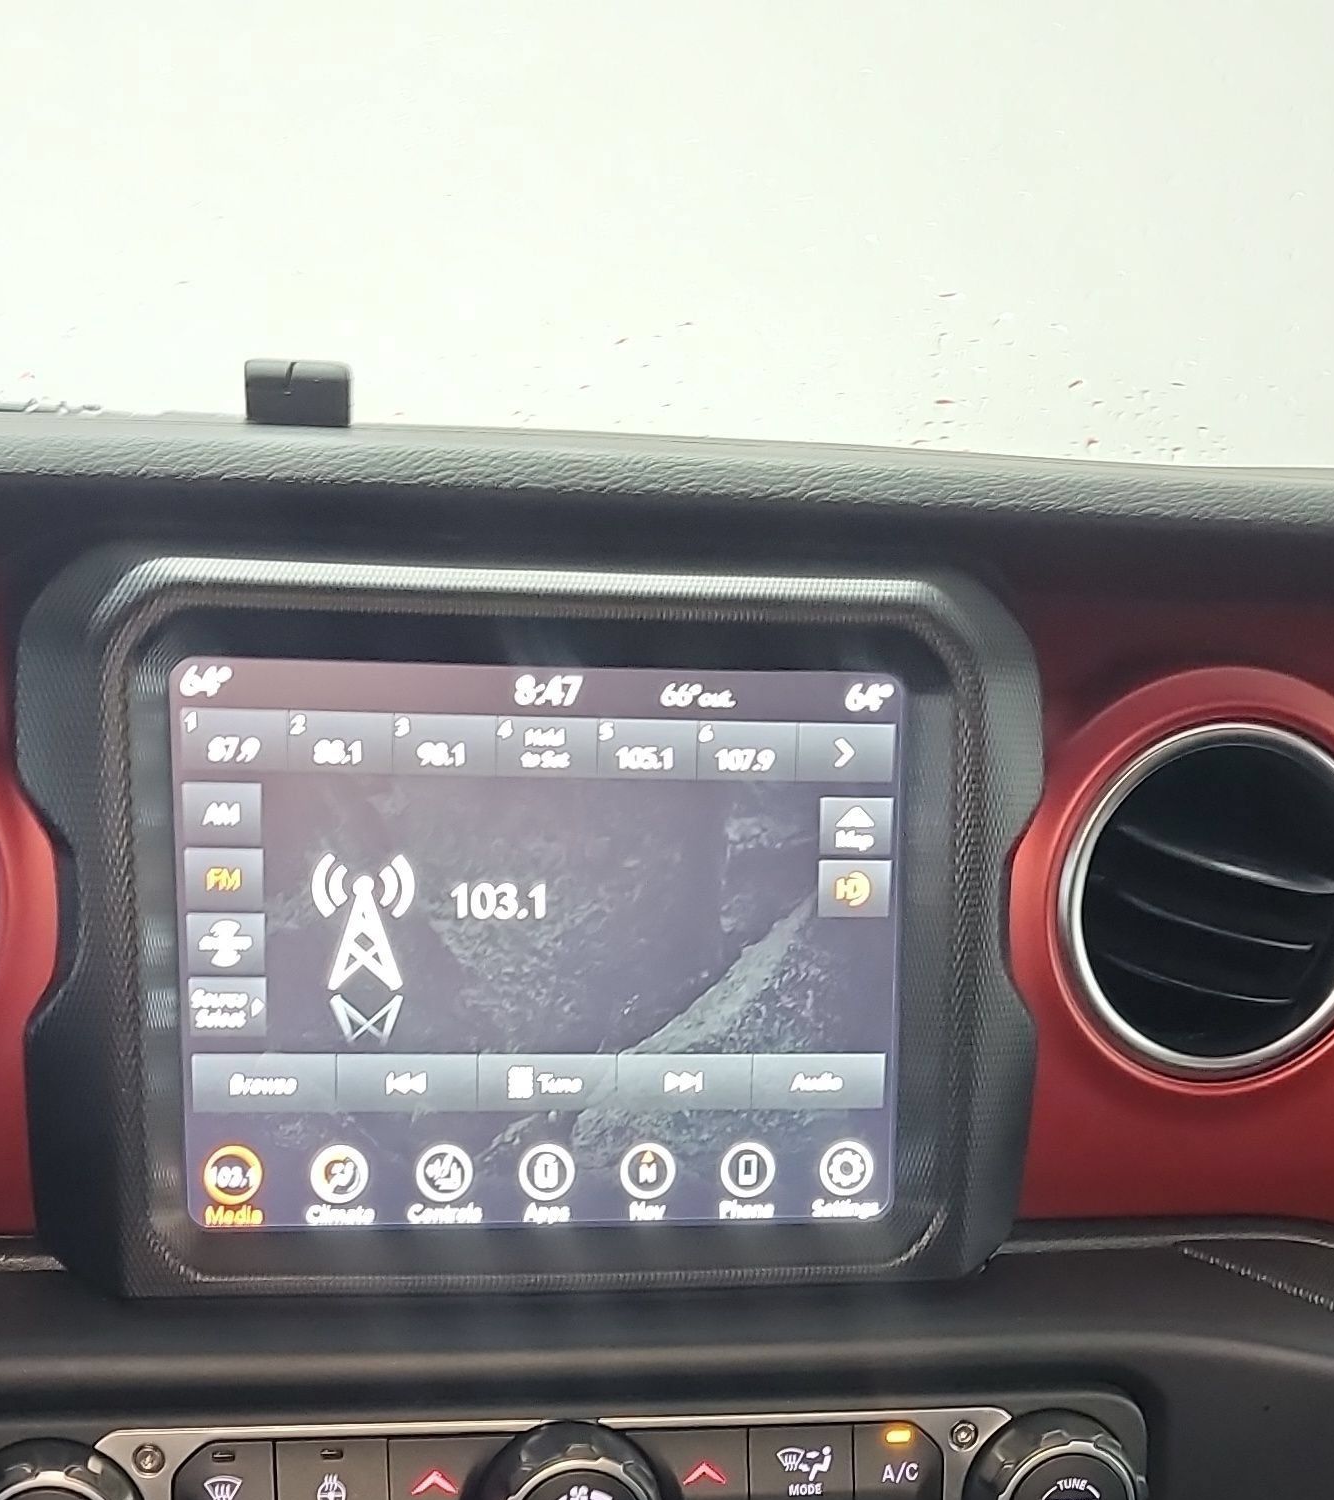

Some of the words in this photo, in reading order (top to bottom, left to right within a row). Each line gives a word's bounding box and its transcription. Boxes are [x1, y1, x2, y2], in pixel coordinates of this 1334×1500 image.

[514, 674, 584, 706] 8:47
[184, 711, 198, 733] 1
[289, 714, 307, 735] 2
[394, 716, 410, 737] 3
[598, 722, 615, 741] 5
[714, 749, 776, 772] 107.9
[206, 867, 242, 892] FM
[450, 882, 547, 921] 103.1
[537, 1073, 583, 1094] Tune
[205, 1206, 264, 1226] Media
[306, 1203, 376, 1226] Climate
[629, 1201, 666, 1220] Nav
[718, 1200, 774, 1220] Phone
[811, 1198, 879, 1220] Settings
[881, 1463, 919, 1483] A/C
[788, 1482, 823, 1496] MODE
[1056, 1478, 1088, 1491] TUNE
